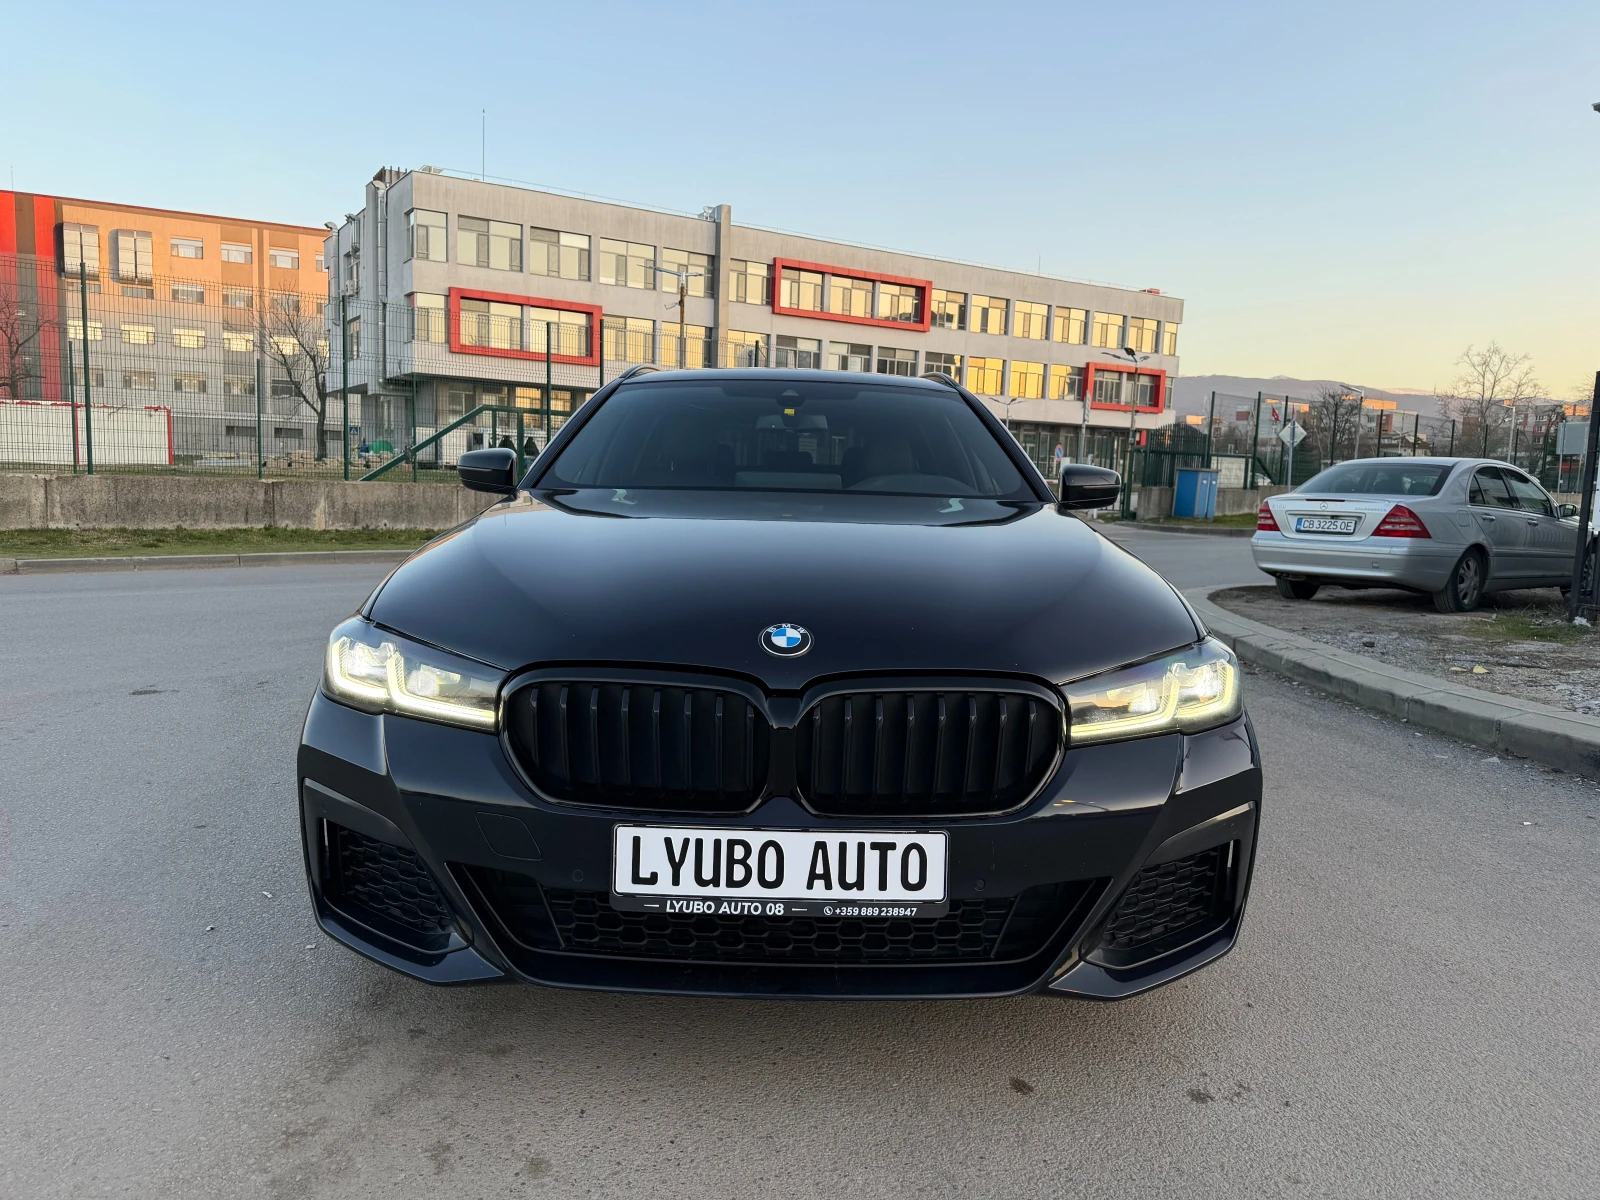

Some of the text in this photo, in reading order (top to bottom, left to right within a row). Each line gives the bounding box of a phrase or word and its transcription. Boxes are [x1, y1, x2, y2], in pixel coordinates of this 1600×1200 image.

[1302, 519, 1314, 529] CB
[1315, 520, 1339, 530] 3225
[767, 623, 807, 634] BMW
[631, 835, 928, 892] LYUBO AUTO
[665, 900, 785, 916] LYUBO AUTO 08
[834, 906, 918, 917] +359 889 238947
